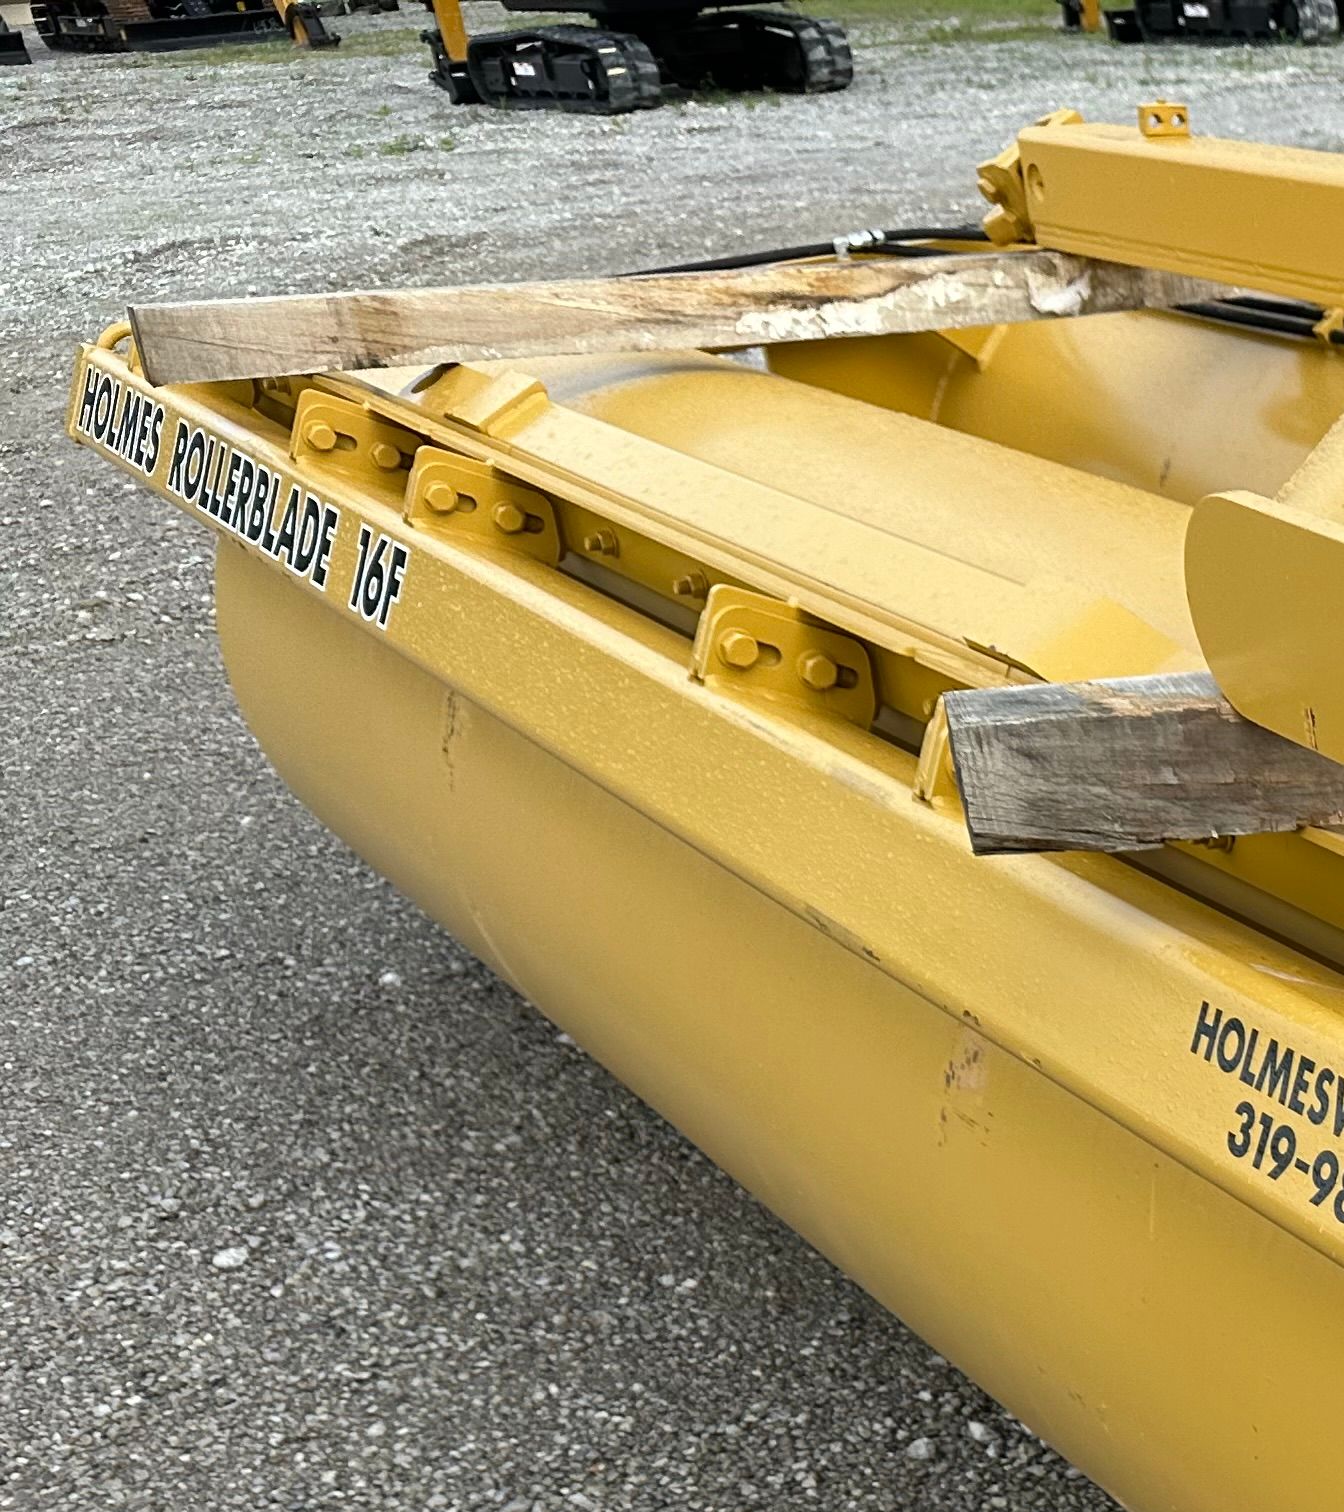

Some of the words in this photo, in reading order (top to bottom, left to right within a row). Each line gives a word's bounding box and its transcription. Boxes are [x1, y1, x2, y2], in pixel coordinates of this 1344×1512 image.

[77, 364, 164, 477] HOLMES
[166, 418, 340, 591] ROLLERBLADE
[348, 520, 411, 630] 16F
